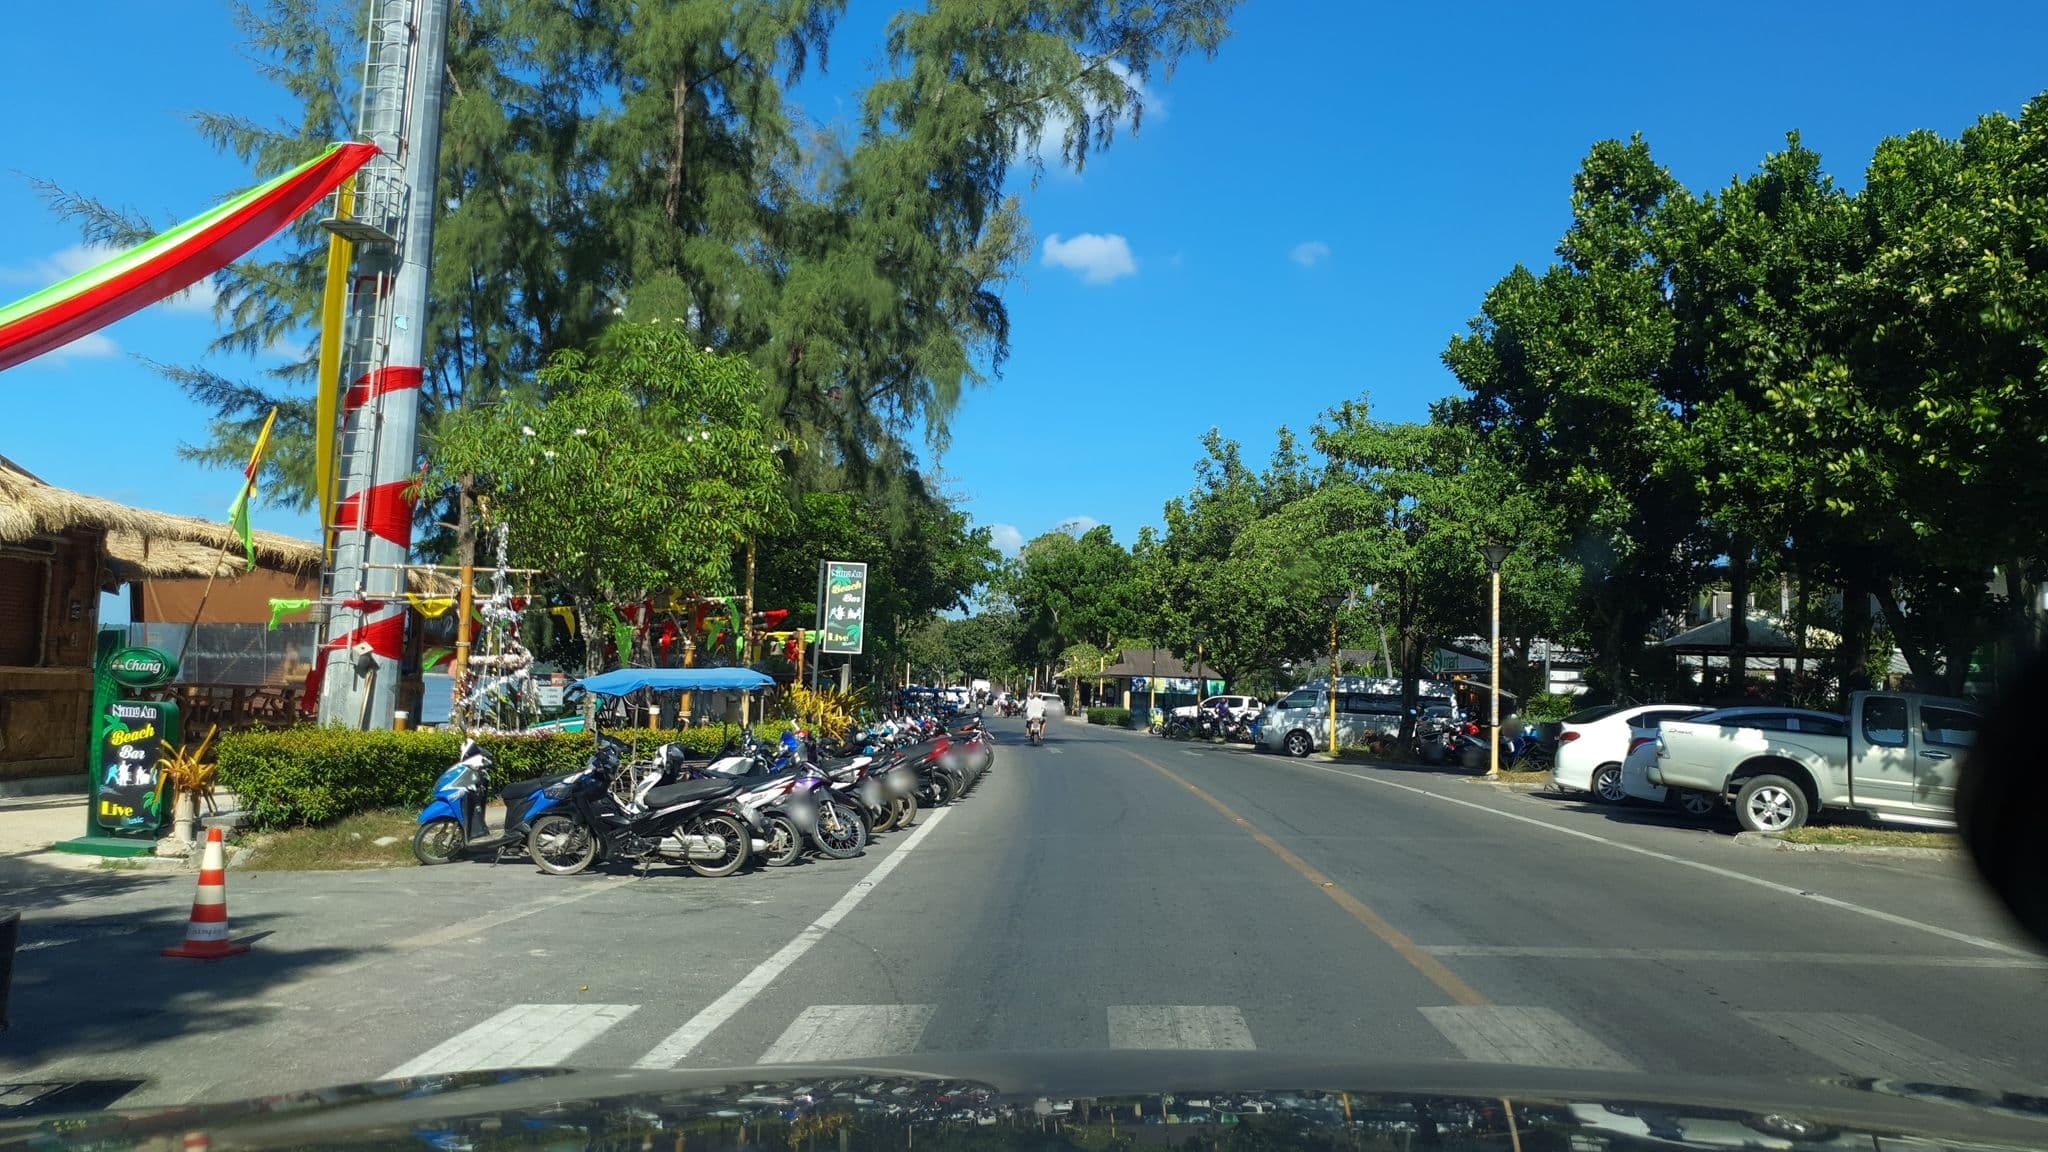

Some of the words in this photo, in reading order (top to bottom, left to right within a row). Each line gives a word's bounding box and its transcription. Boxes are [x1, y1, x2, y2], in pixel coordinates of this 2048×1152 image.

[827, 632, 848, 642] Live
[125, 659, 162, 673] Chang
[111, 723, 155, 745] Beach
[119, 745, 145, 759] Bar
[101, 801, 133, 816] Live
